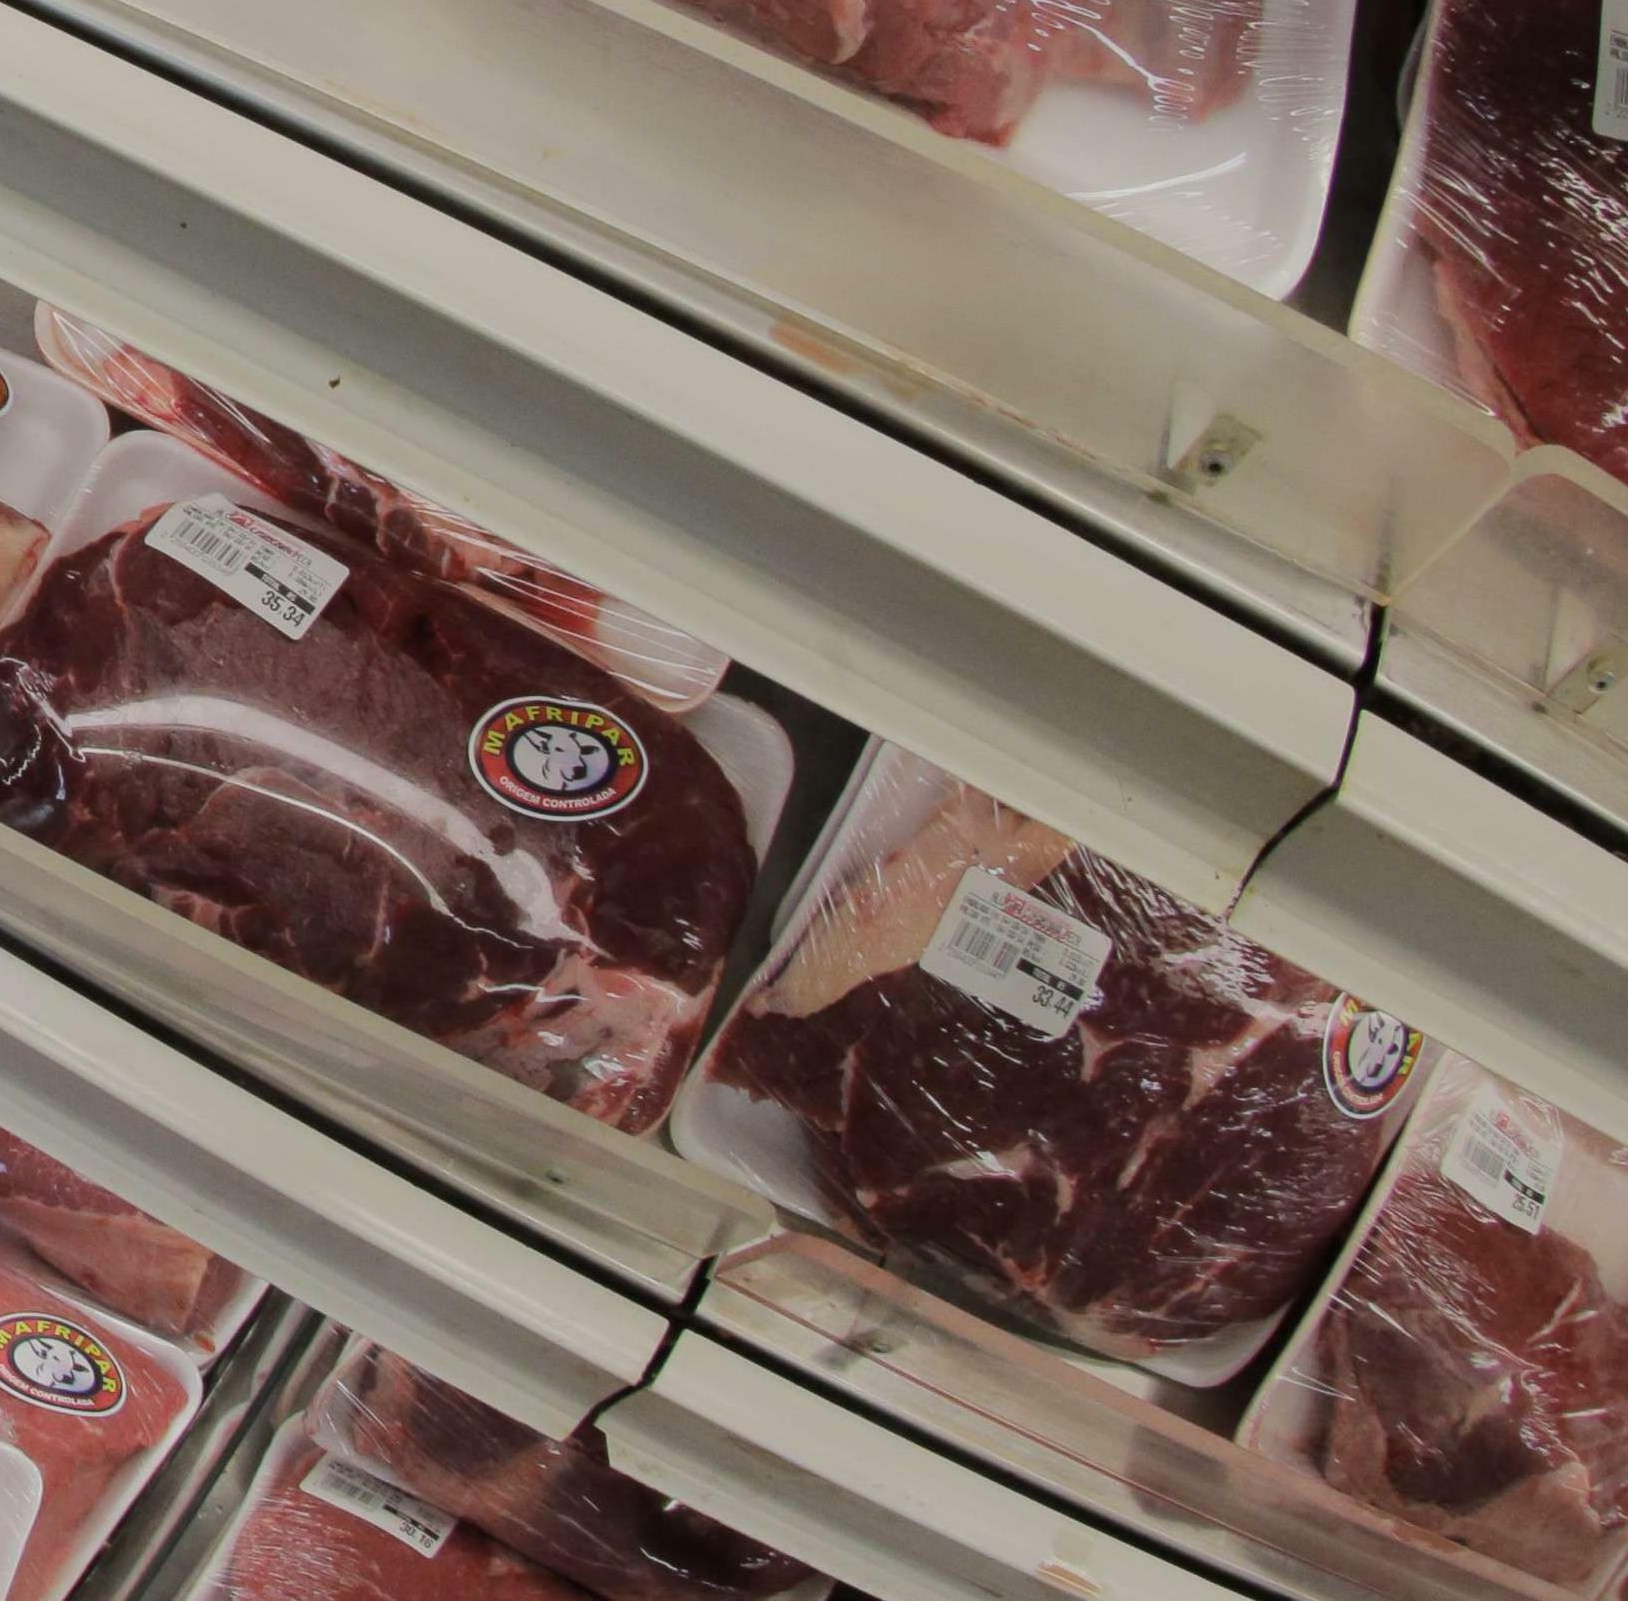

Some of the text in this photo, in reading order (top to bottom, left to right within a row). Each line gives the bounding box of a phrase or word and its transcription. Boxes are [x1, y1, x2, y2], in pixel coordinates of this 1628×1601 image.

[482, 705, 635, 767] MAFRIPAR
[499, 774, 618, 811] ORIGEM CONTROLADA
